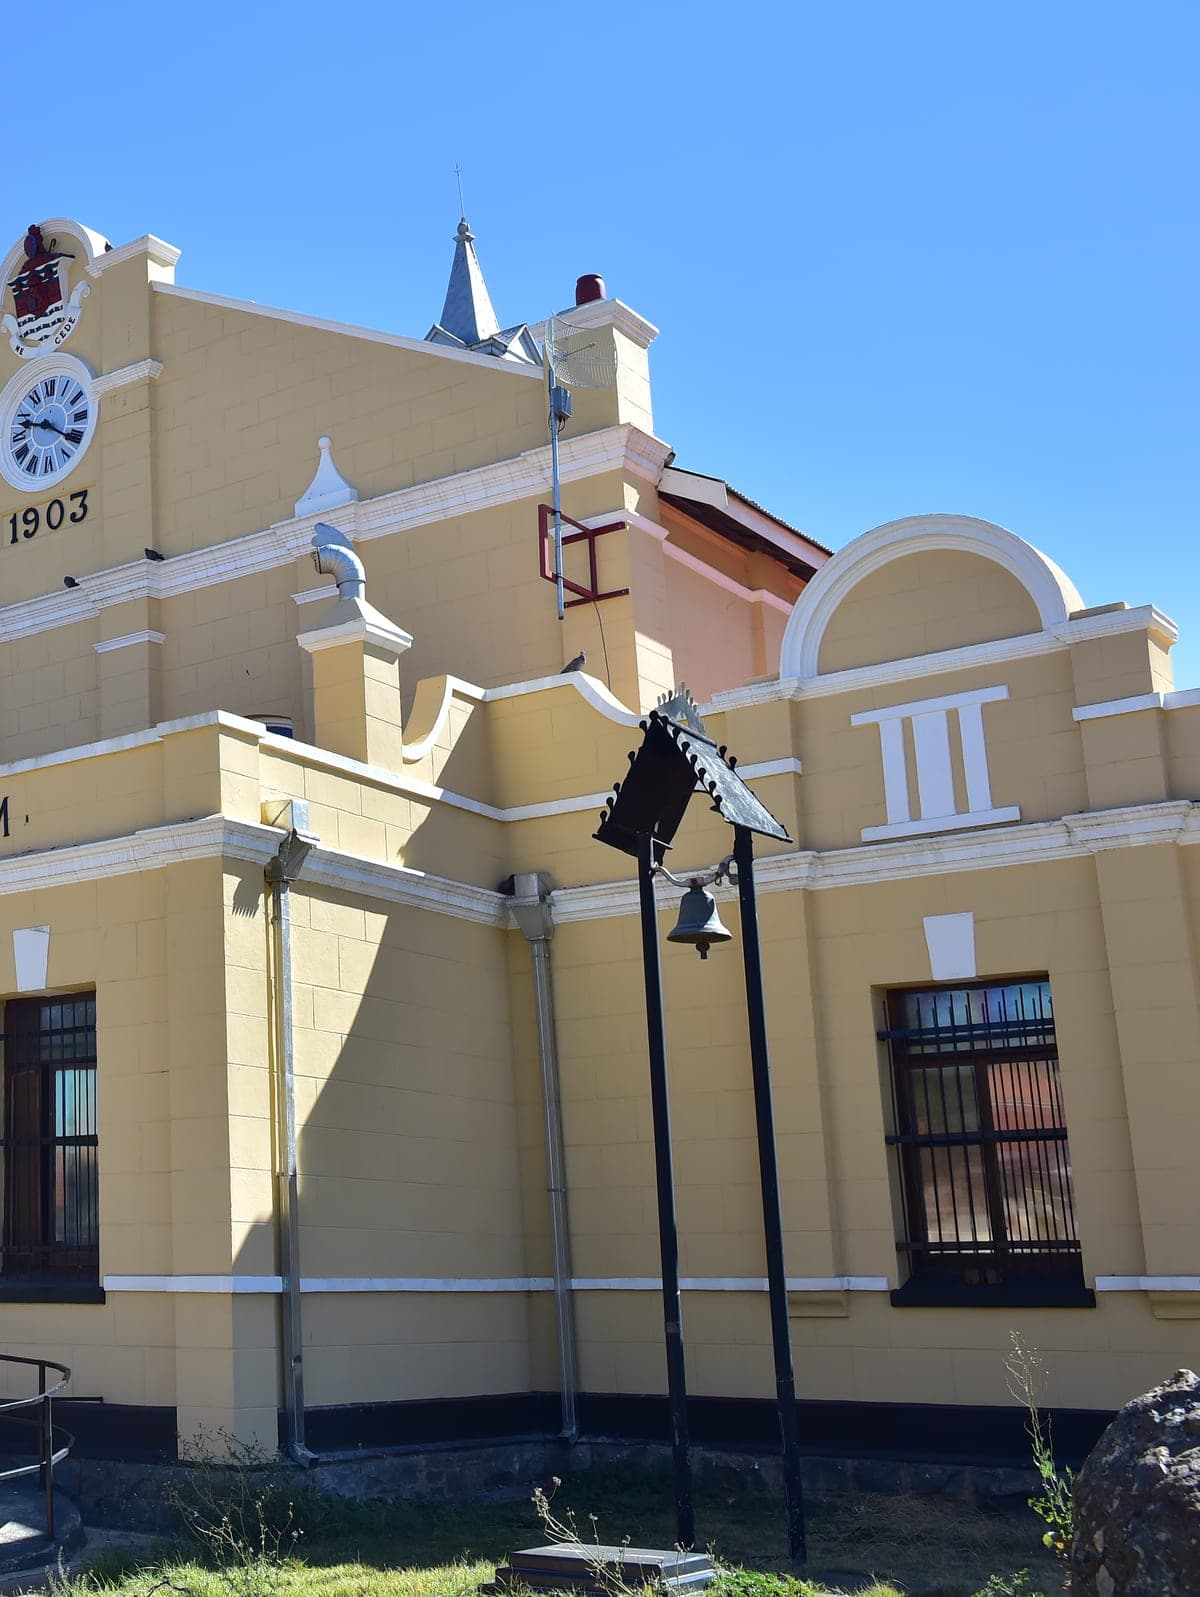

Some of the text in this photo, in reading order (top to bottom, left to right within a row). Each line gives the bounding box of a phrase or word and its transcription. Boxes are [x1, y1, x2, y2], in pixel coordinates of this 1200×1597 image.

[15, 316, 76, 356] NE CEDE
[61, 379, 70, 397] I
[28, 389, 41, 408] XI
[69, 390, 84, 406] II
[73, 409, 88, 423] III
[12, 429, 26, 442] IX
[44, 455, 53, 474] VI
[60, 448, 71, 463] V
[9, 489, 89, 544] 1903
